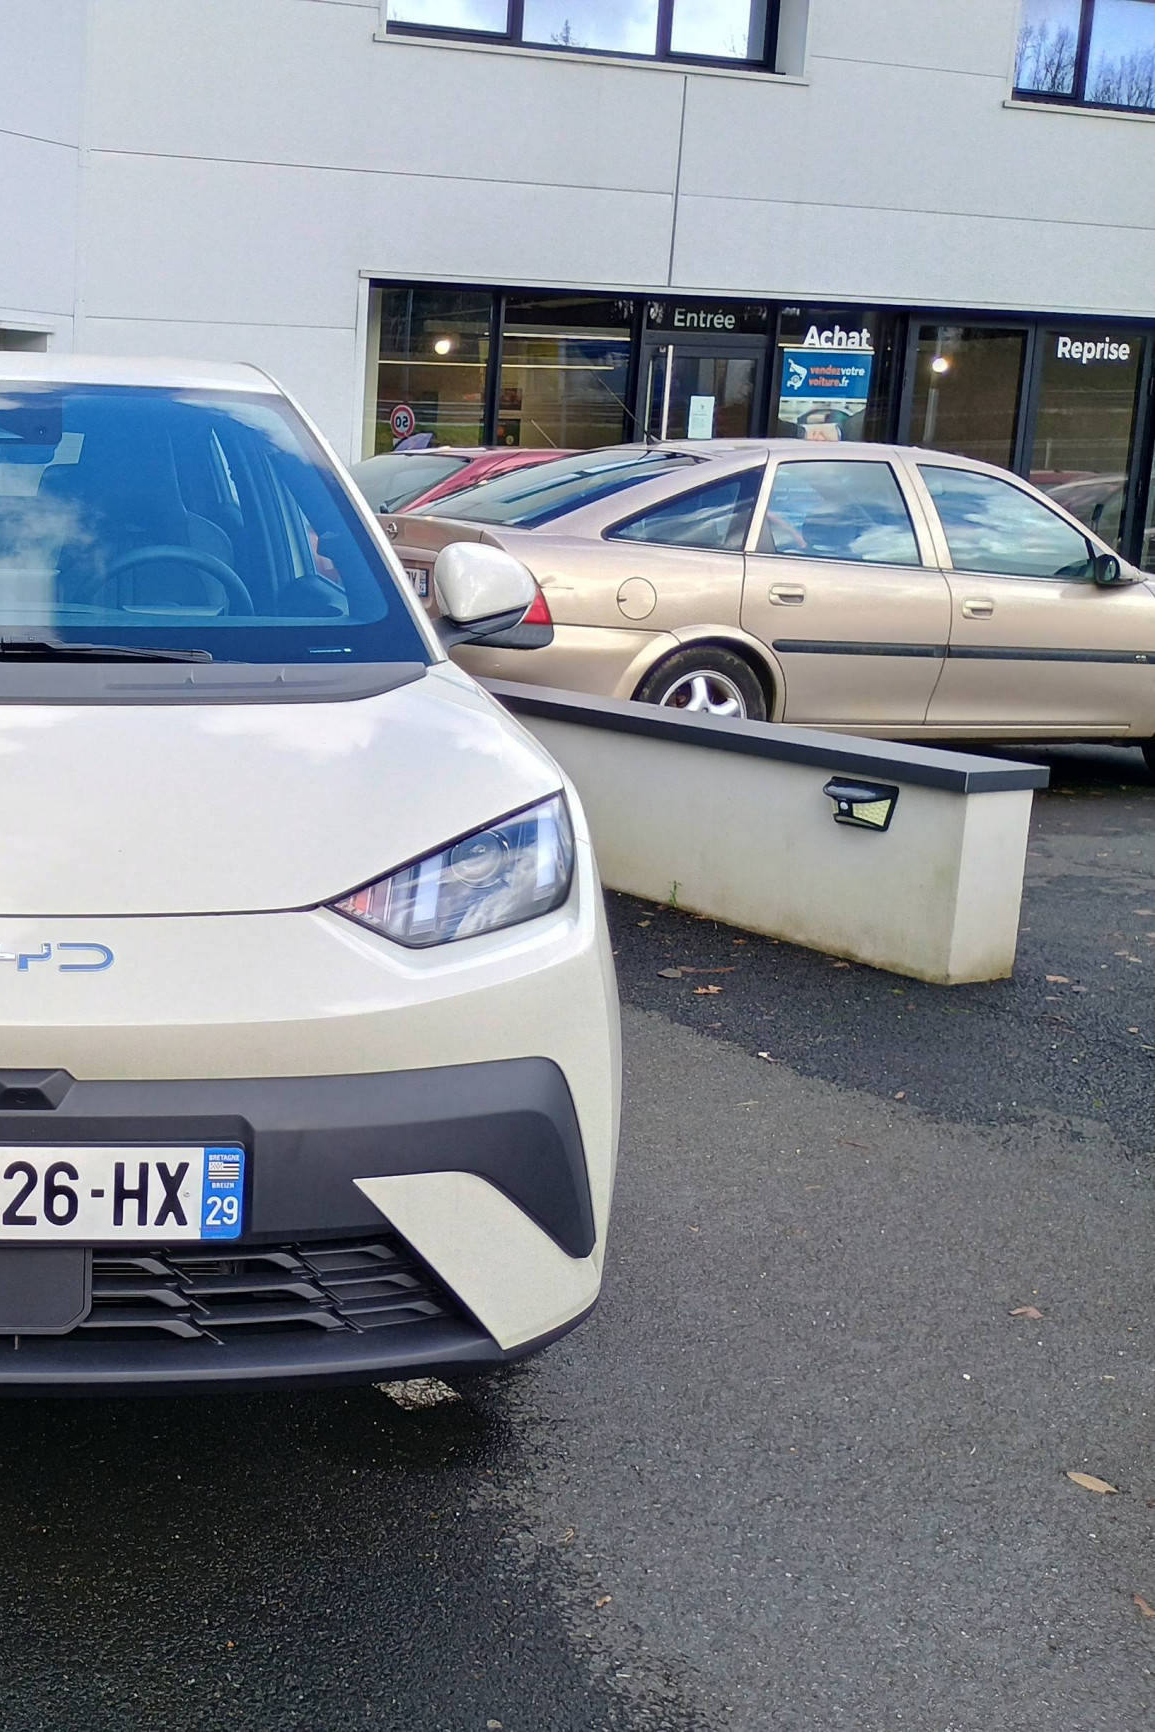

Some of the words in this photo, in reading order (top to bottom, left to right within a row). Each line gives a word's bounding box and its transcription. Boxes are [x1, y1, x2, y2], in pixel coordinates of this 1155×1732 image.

[674, 308, 736, 329] Entrée
[803, 325, 874, 348] Achat
[1057, 336, 1130, 364] Reprise
[809, 365, 866, 376] vendezvotre
[808, 376, 850, 387] voiture.fr
[208, 1154, 240, 1162] BRETAGNE
[205, 1196, 239, 1225] 29
